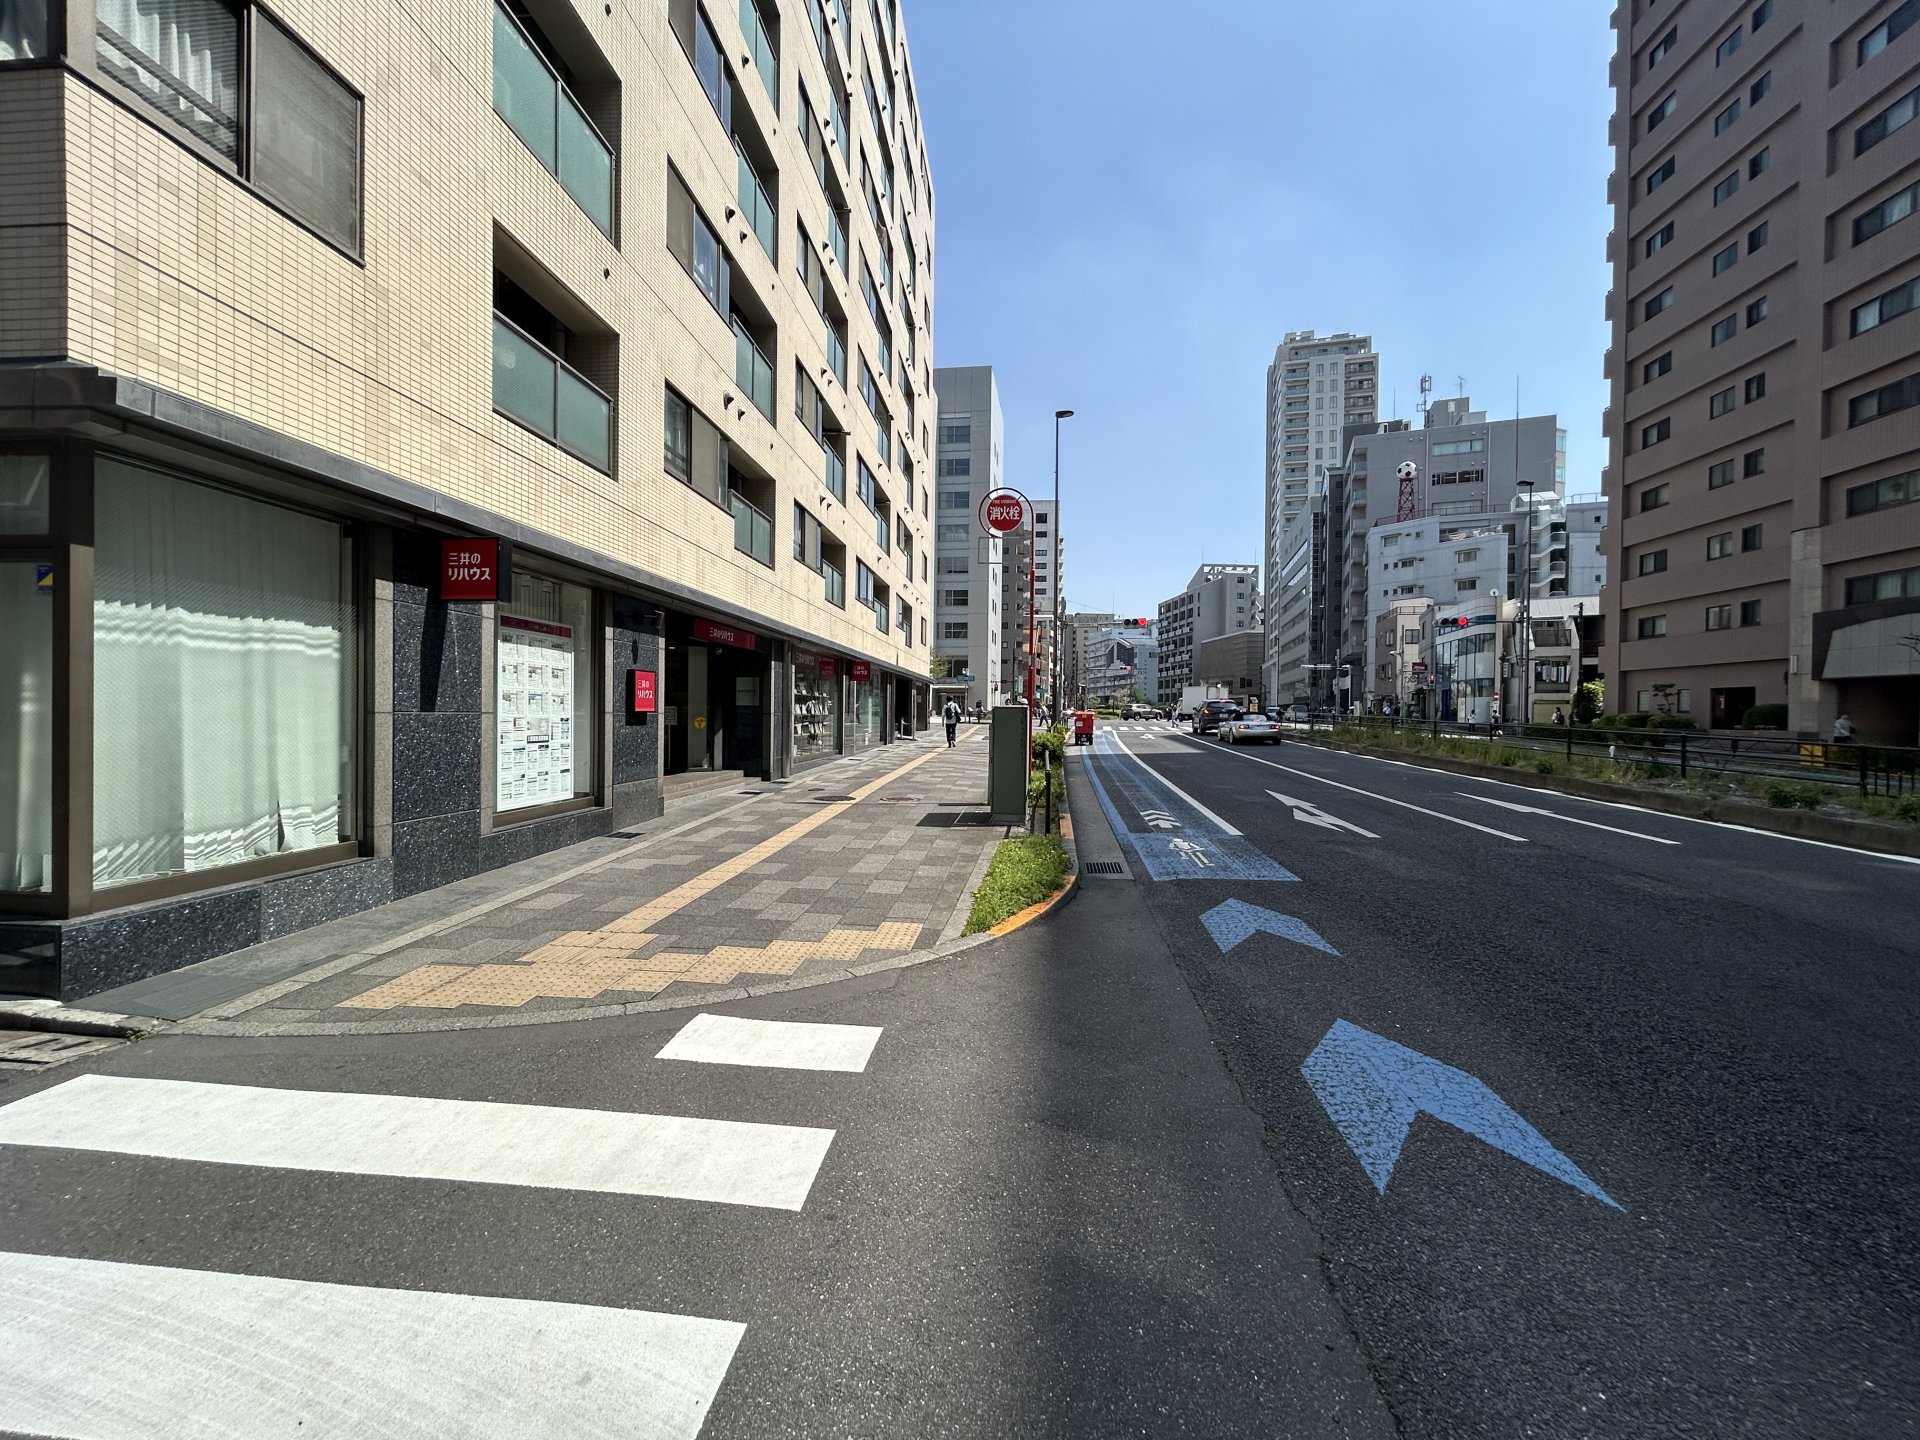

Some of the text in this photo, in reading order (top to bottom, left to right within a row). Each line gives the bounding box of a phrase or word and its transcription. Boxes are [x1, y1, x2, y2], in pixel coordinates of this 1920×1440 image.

[989, 505, 1021, 521] 消火栓
[449, 552, 481, 565] 三井の
[448, 567, 491, 581] リハウス
[637, 680, 650, 688] 三井の
[637, 690, 653, 699] リハウス
